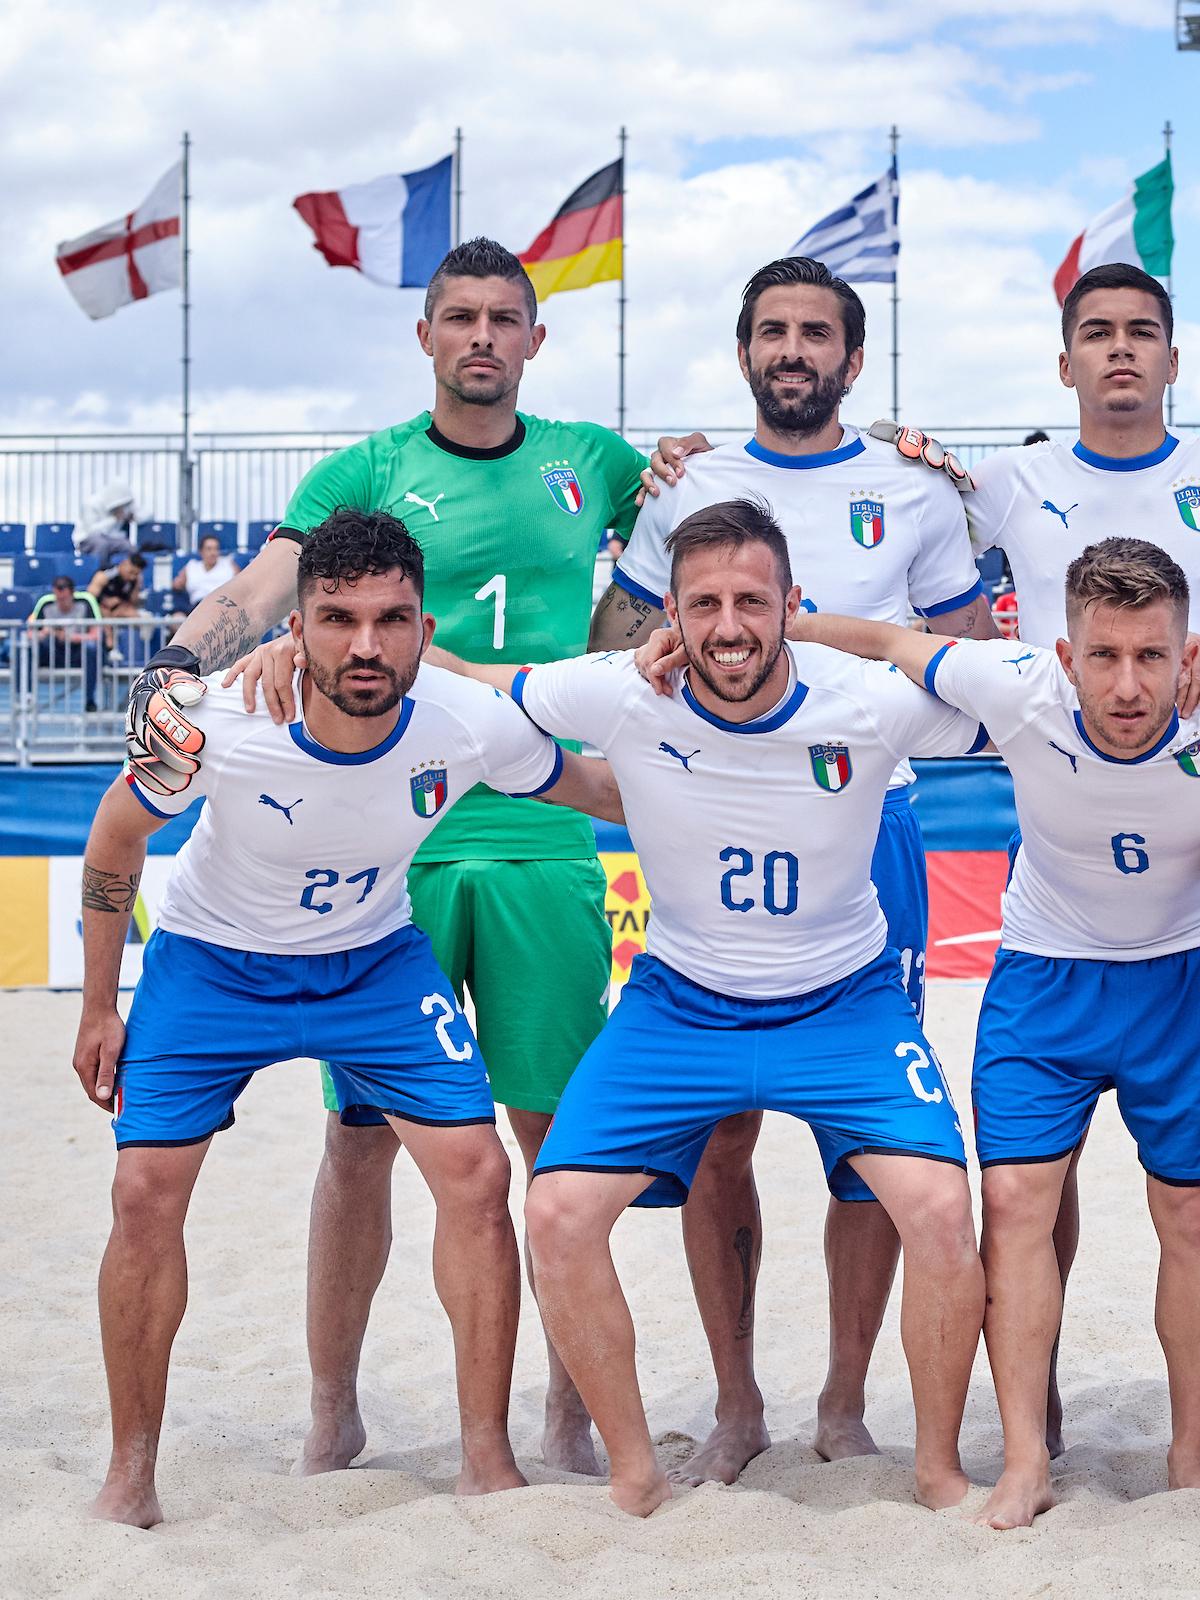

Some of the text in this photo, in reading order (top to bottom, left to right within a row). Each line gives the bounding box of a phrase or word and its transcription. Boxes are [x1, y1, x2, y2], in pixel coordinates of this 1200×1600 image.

[546, 471, 574, 483] ITALIA
[852, 503, 882, 513] ITALIA
[475, 574, 507, 650] 1
[413, 772, 444, 787] ITALIA
[1111, 832, 1150, 875] 6
[299, 867, 380, 915] 21
[719, 846, 799, 916] 20
[420, 992, 474, 1062] 2
[894, 1042, 957, 1104] 2
